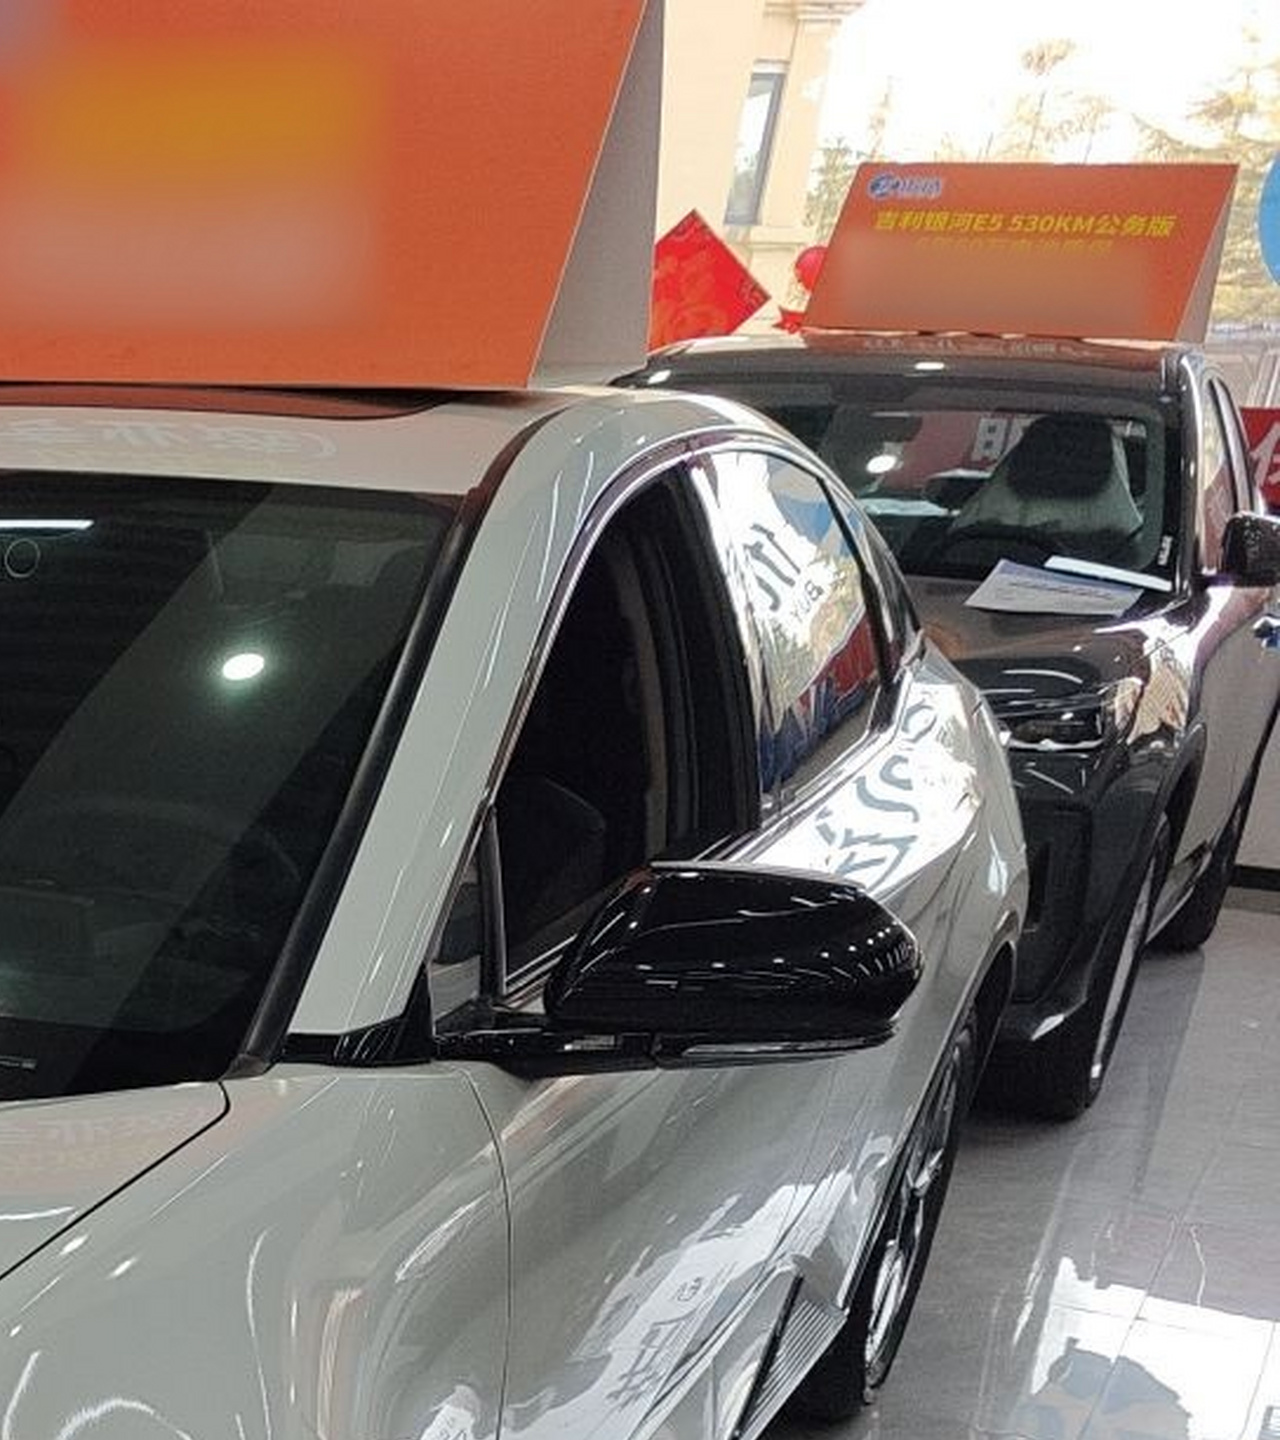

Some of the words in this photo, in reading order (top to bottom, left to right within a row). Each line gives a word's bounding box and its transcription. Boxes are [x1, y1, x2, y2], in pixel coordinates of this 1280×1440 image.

[874, 209, 1003, 233] 吉利银河E5
[1008, 212, 1177, 237] 530KM公务版
